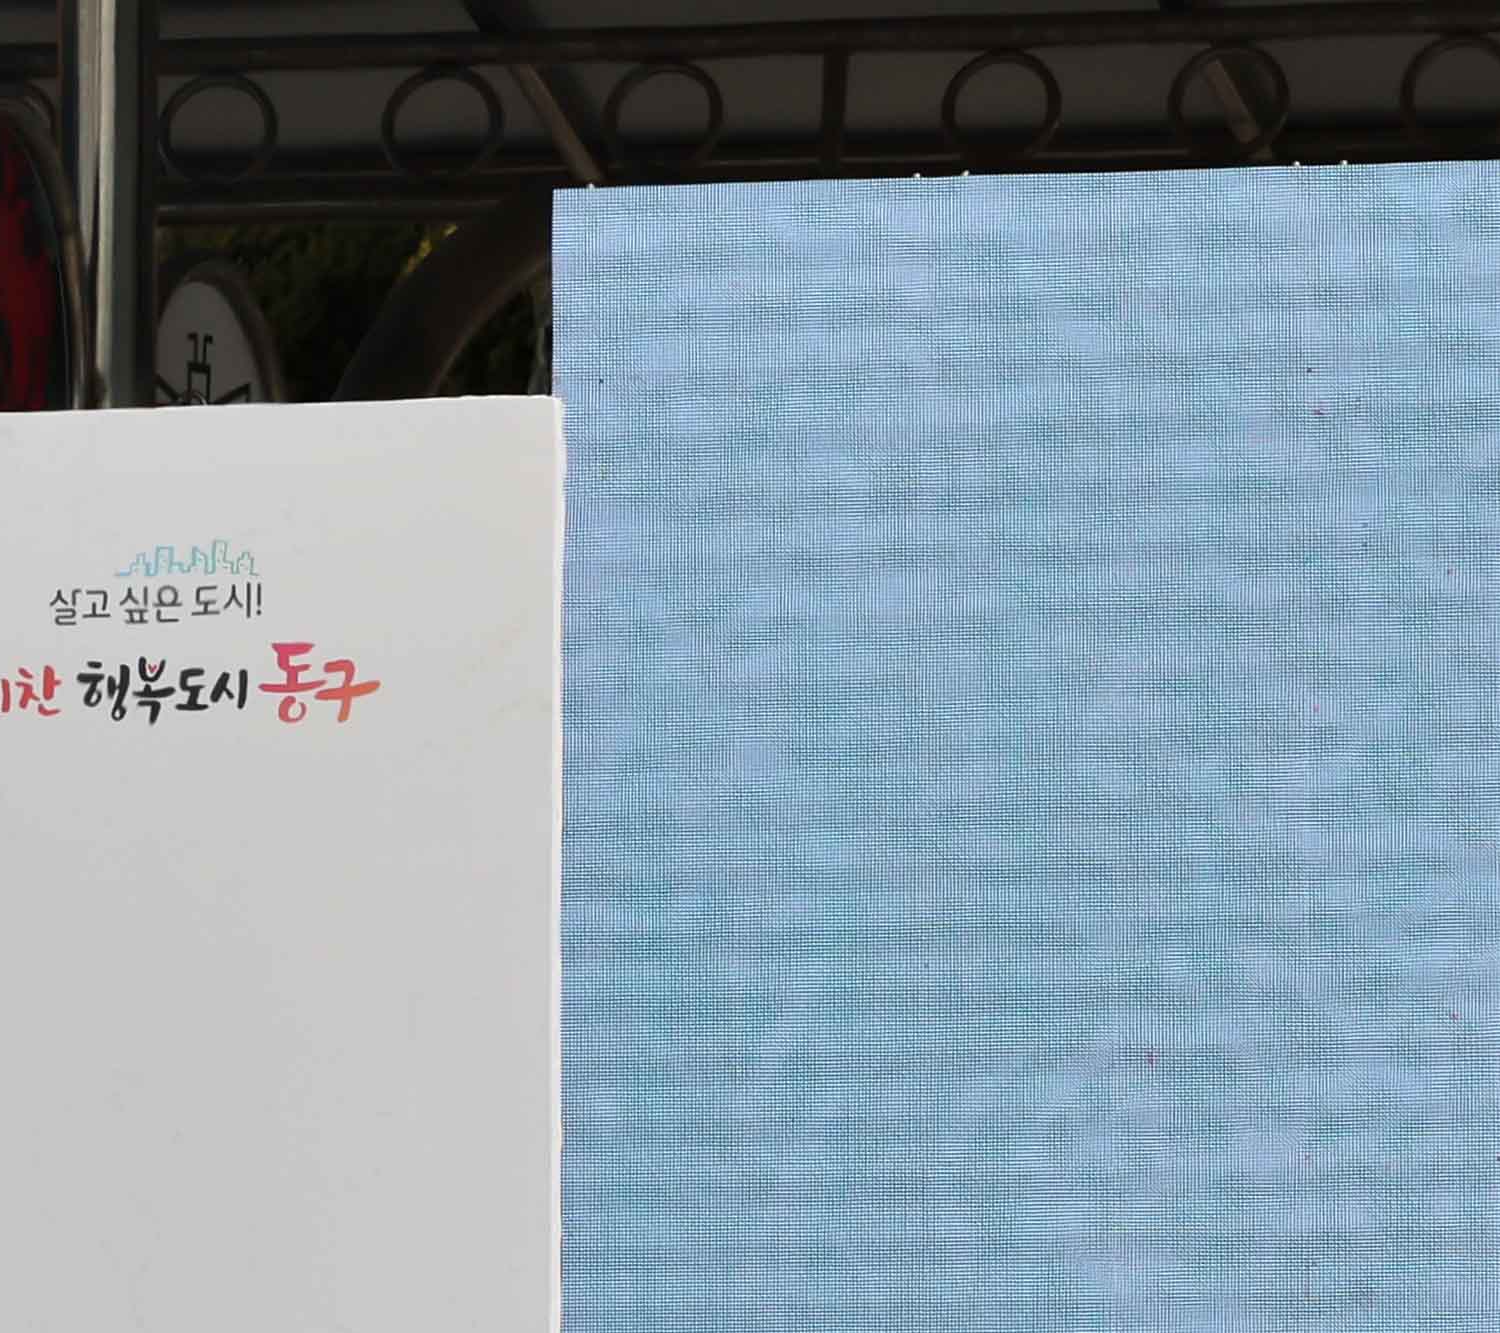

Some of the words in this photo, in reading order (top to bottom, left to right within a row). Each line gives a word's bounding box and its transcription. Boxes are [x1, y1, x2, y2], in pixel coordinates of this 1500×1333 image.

[49, 588, 111, 626] 살고
[119, 585, 183, 625] 싶은
[191, 582, 263, 620] 도시!
[76, 656, 249, 725] 행복도시
[258, 641, 381, 723] 동구
